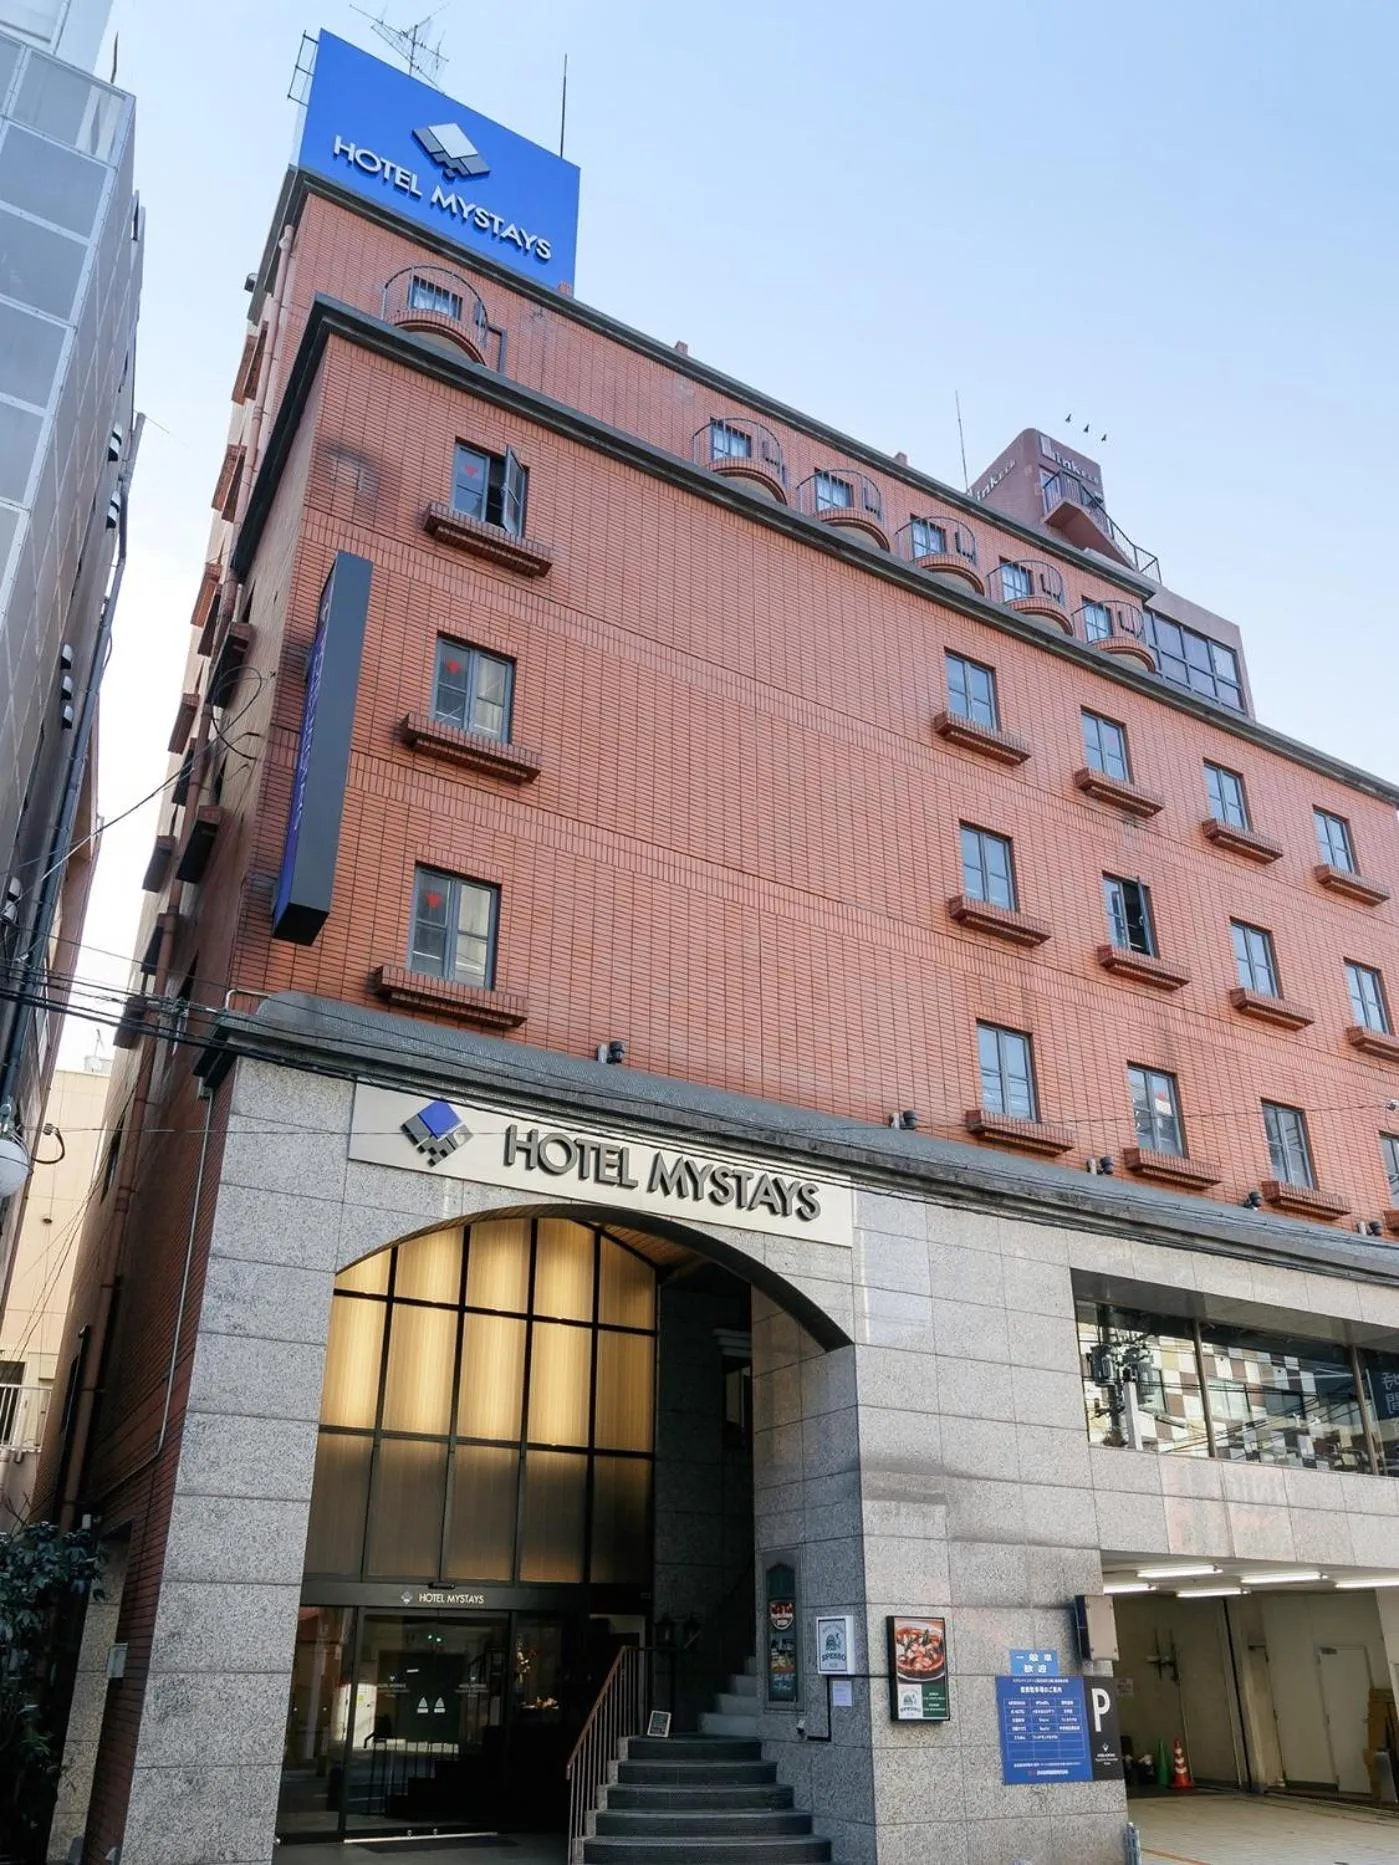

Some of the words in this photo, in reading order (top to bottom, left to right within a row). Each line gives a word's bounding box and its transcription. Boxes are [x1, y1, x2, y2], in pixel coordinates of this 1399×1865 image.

[333, 134, 422, 197] HOTEL
[431, 185, 553, 260] MYSTAYS
[504, 1124, 637, 1188] HOTEL
[648, 1151, 822, 1220] MYSTAYS
[419, 1593, 444, 1603] HOTEL
[447, 1594, 484, 1605] MYSTAYS
[1091, 1687, 1111, 1733] P
